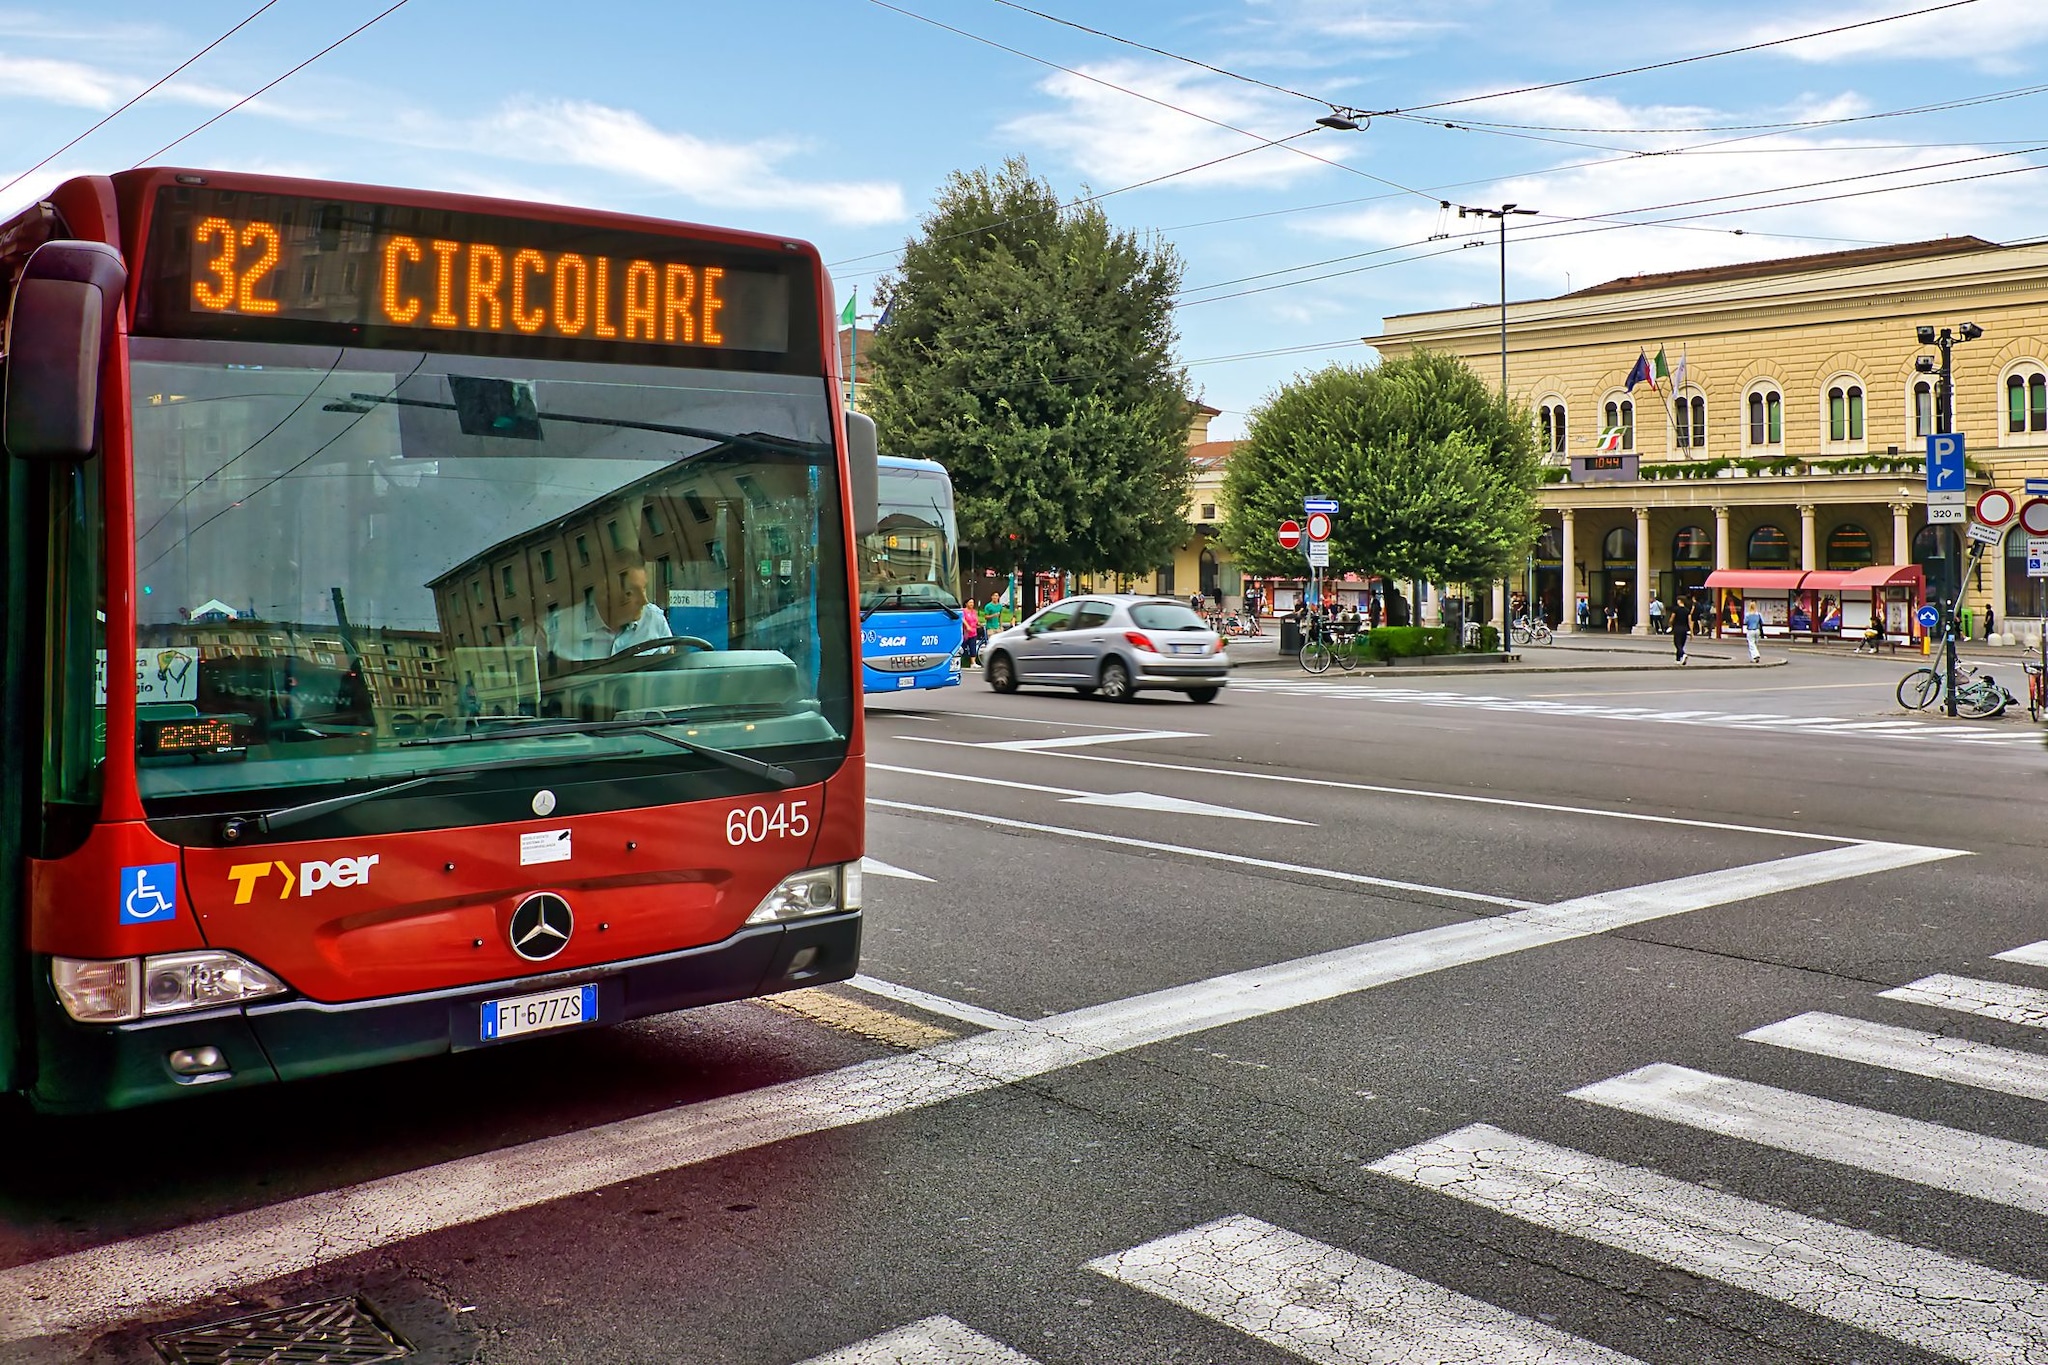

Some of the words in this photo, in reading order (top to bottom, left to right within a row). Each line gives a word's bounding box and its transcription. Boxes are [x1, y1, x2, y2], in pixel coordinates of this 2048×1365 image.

[196, 216, 279, 312] 32
[384, 234, 725, 344] CIRCOLARE
[1934, 438, 1955, 466] P
[1933, 509, 1952, 518] 320
[922, 636, 938, 646] 2076
[890, 655, 927, 668] IVECO
[160, 724, 232, 748] 2256
[726, 800, 810, 846] 6045
